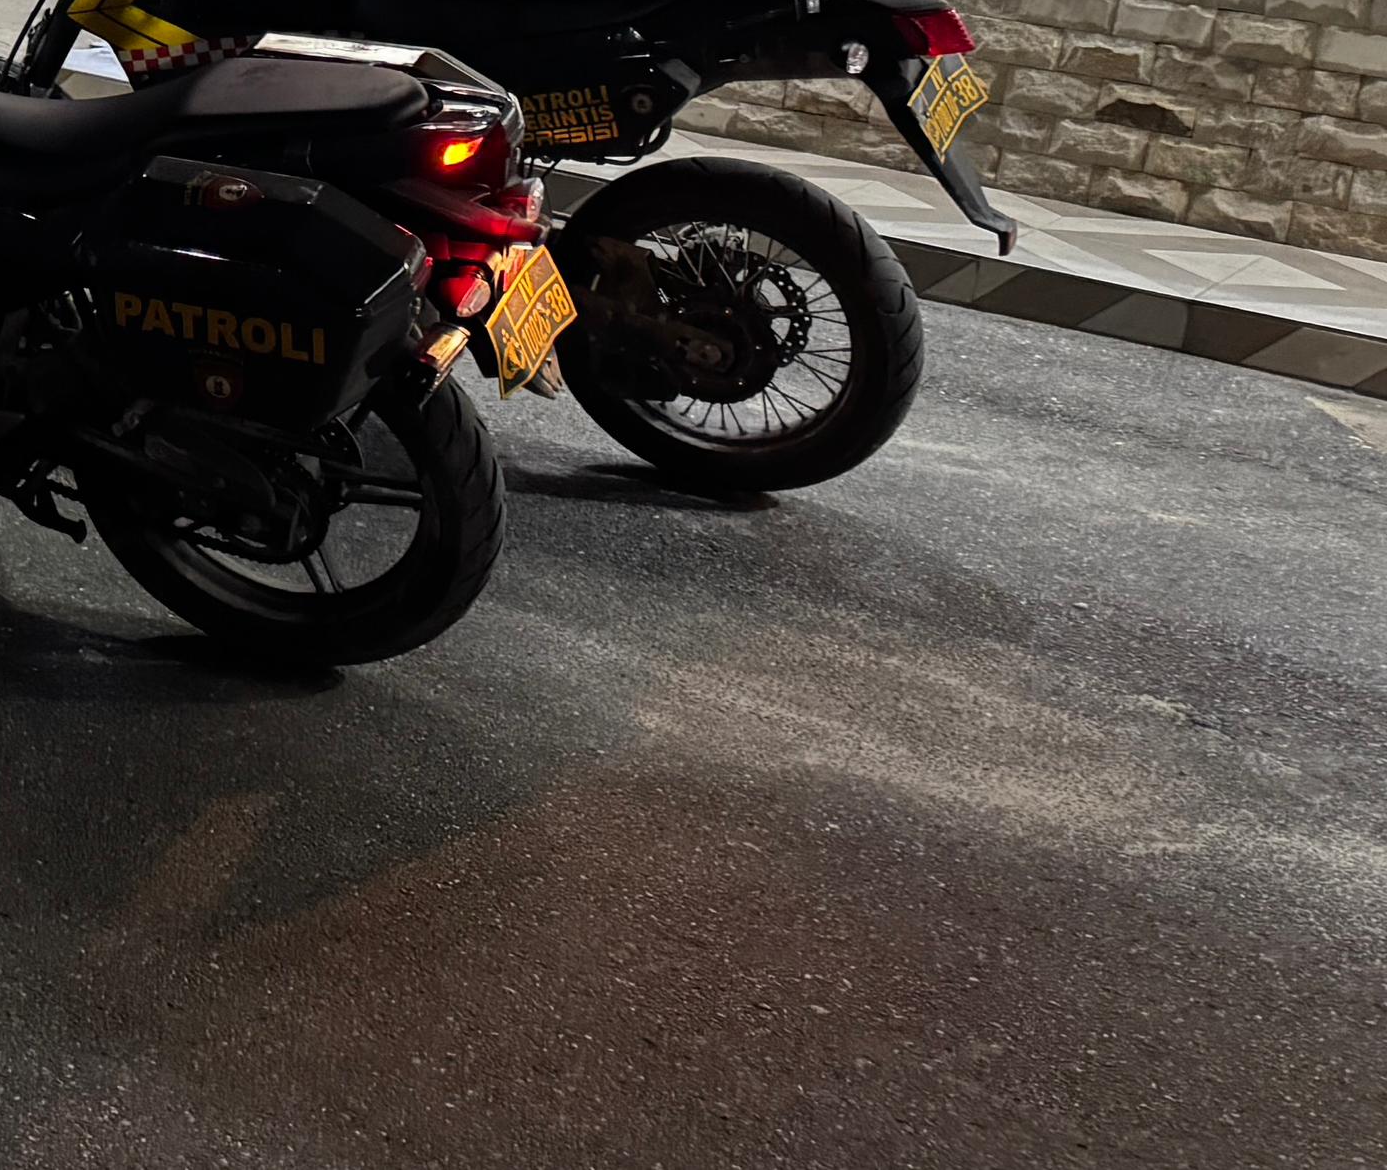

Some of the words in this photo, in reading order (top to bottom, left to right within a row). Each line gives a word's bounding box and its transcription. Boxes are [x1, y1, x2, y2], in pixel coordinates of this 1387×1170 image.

[523, 85, 610, 113] ATROLI
[524, 104, 615, 130] ERINTIS
[517, 270, 535, 305] IV
[114, 291, 326, 365] PATROLI
